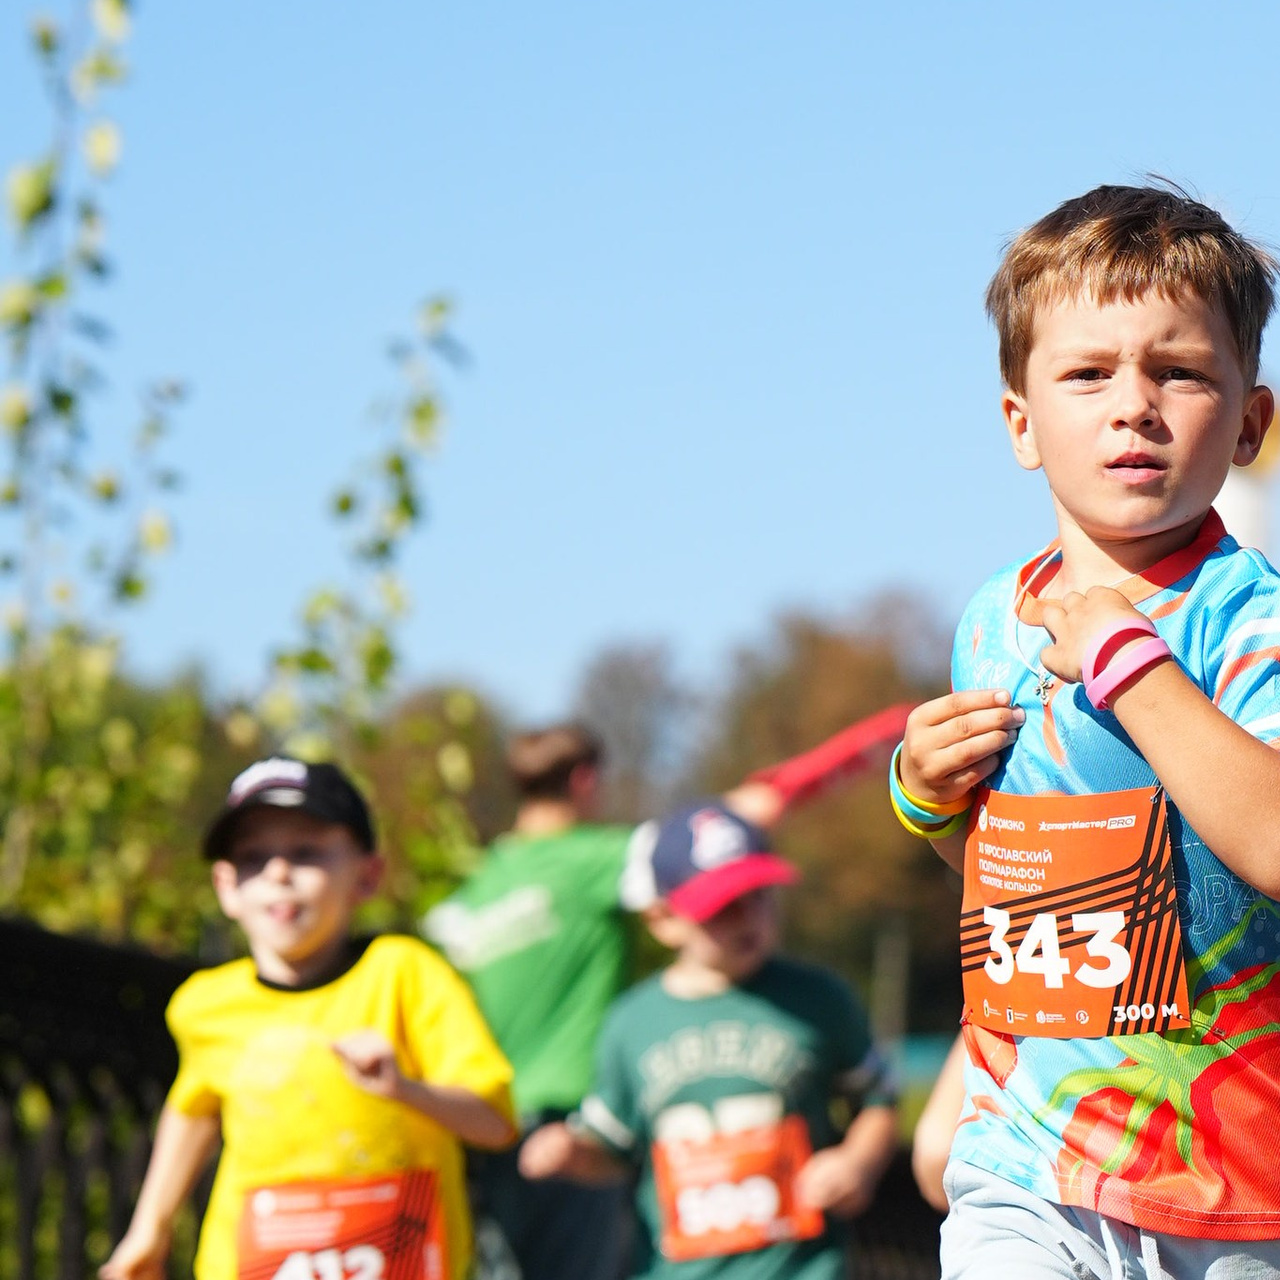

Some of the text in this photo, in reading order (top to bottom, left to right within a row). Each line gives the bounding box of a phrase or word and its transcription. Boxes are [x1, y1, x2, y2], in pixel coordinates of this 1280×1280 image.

[1108, 816, 1134, 827] PRO
[984, 843, 1052, 864] ЯРОСЛАВСКИЙ
[979, 858, 1045, 881] ПОЛУМАРАФОН
[983, 906, 1132, 989] 343
[1113, 1003, 1155, 1023] 300
